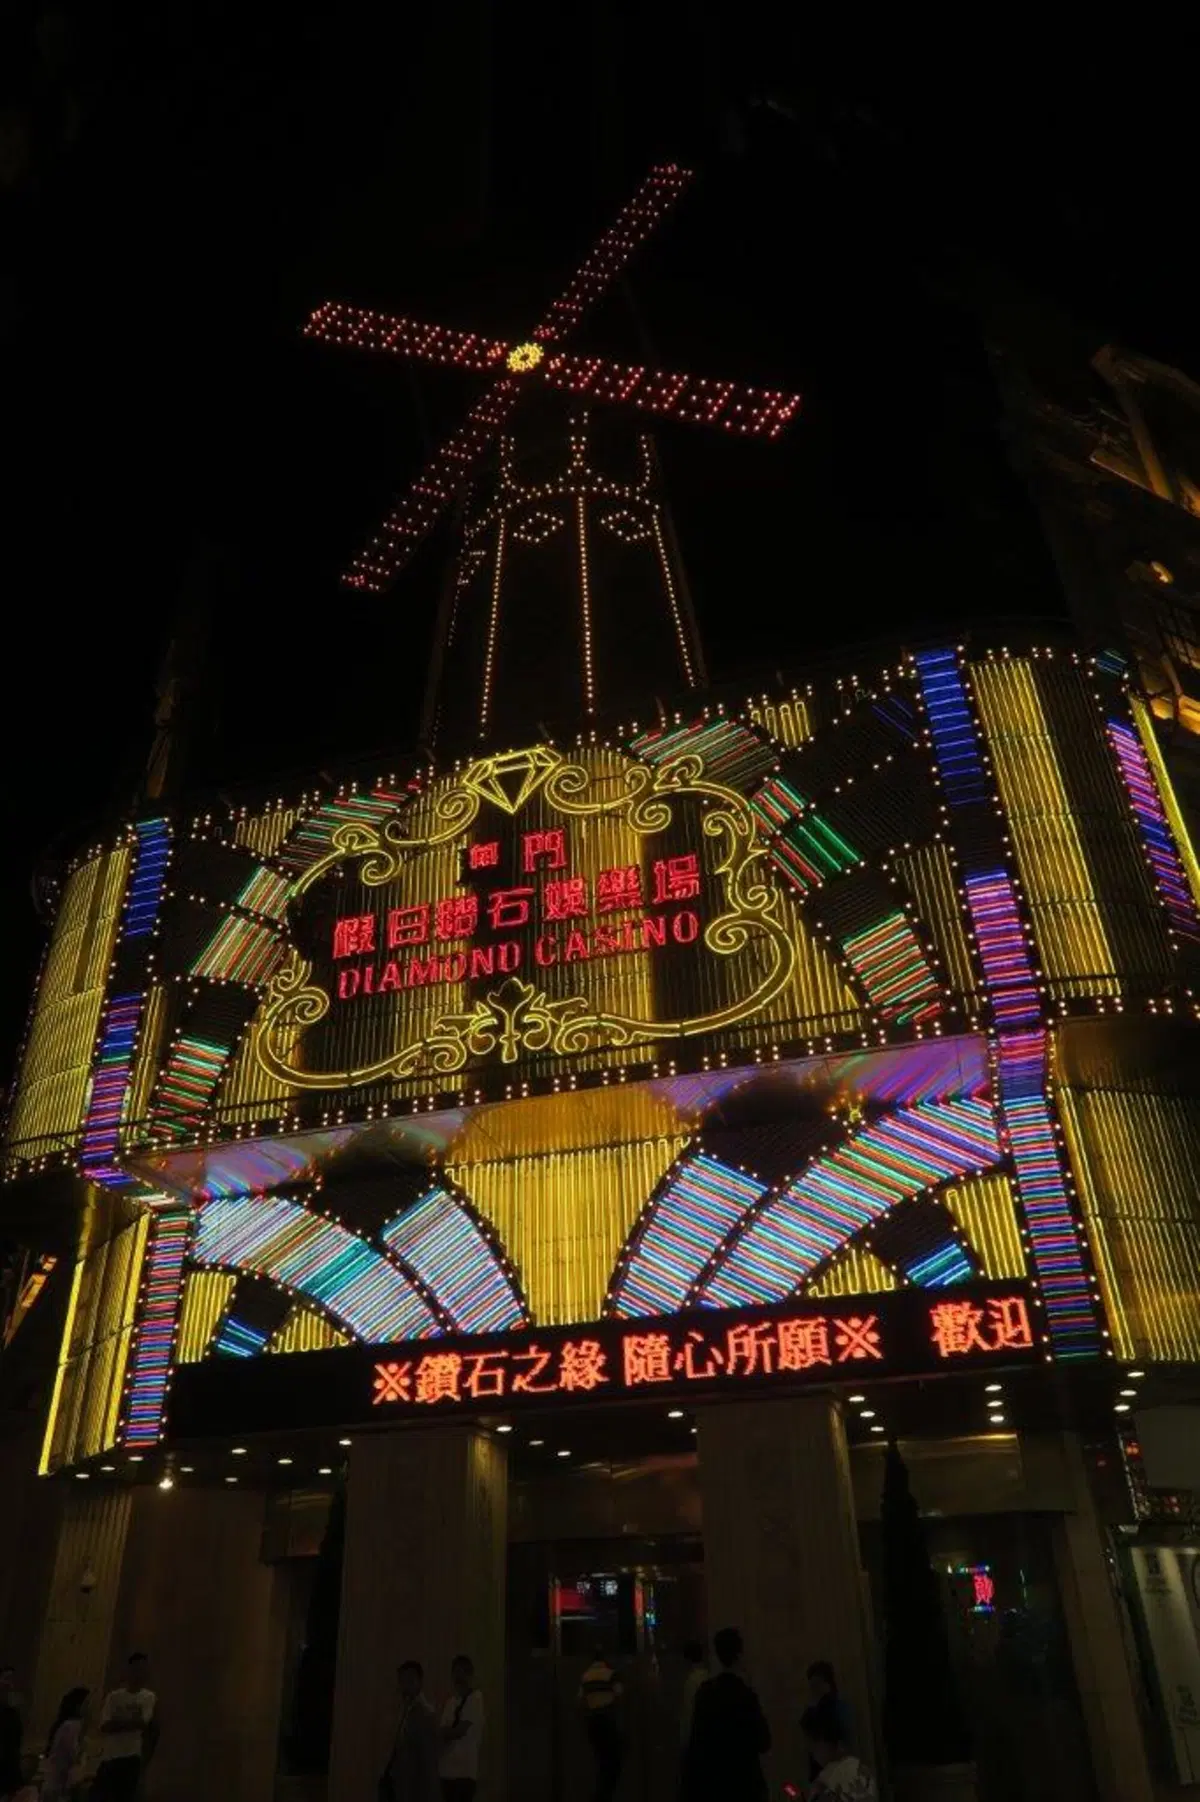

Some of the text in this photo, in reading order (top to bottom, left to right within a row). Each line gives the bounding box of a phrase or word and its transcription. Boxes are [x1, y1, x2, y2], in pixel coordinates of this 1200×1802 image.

[338, 911, 699, 999] DIAMOND CASINO
[929, 1297, 1034, 1357] 歡迎
